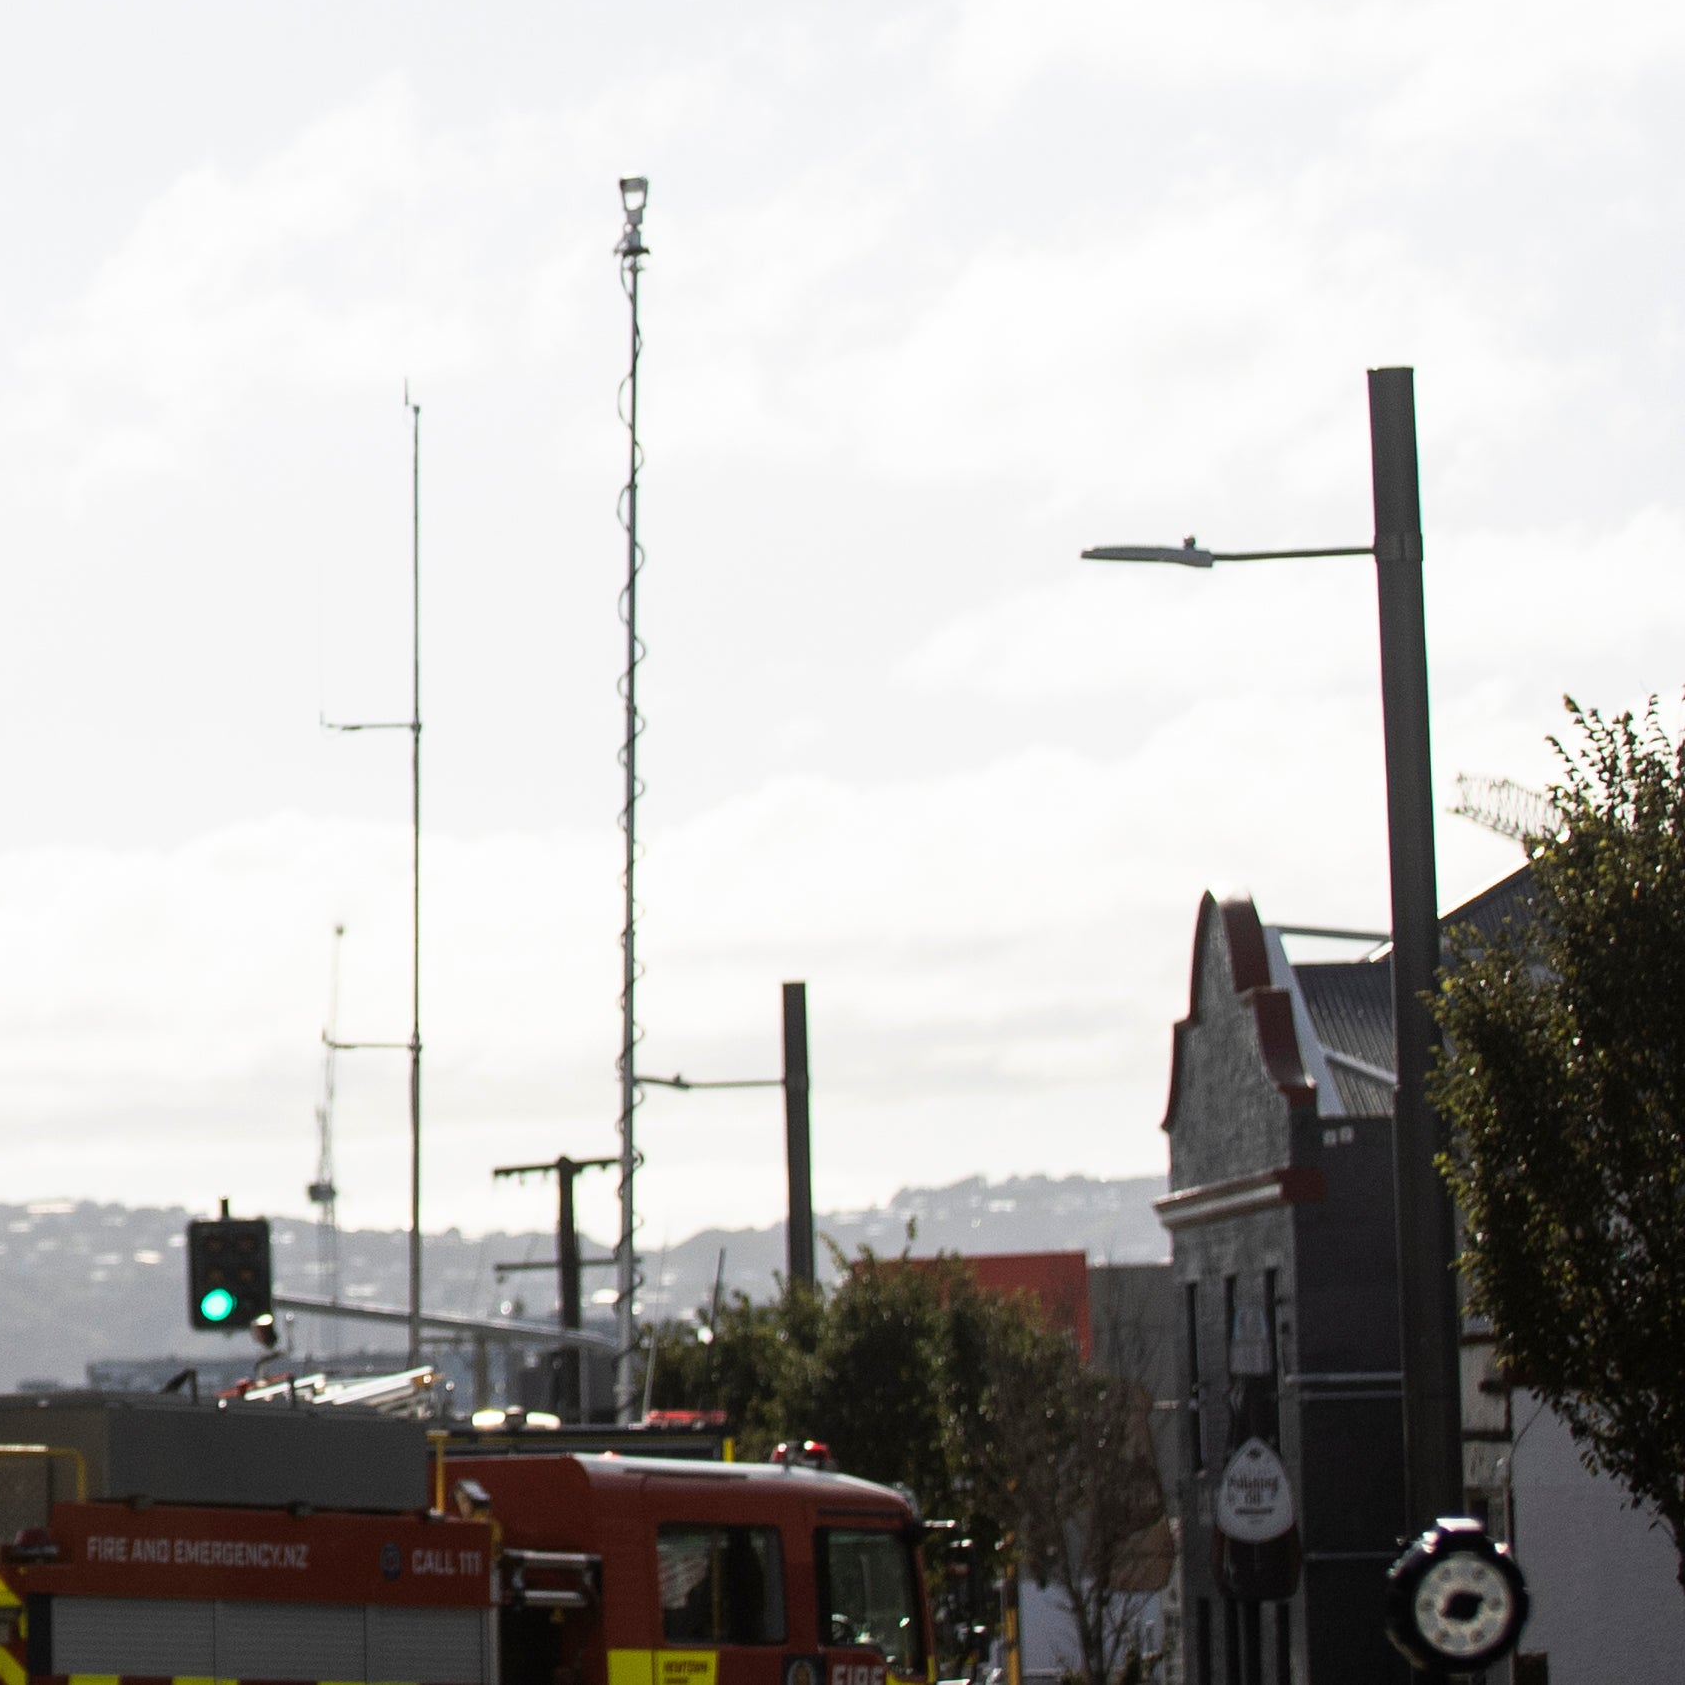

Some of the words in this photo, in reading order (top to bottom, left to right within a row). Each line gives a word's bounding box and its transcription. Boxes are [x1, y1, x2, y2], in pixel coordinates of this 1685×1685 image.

[86, 1536, 127, 1563] FIRE
[131, 1538, 170, 1564] AND
[173, 1539, 309, 1570] EMERGENCY.NZ
[412, 1548, 454, 1575] CALL
[458, 1551, 483, 1575] 111
